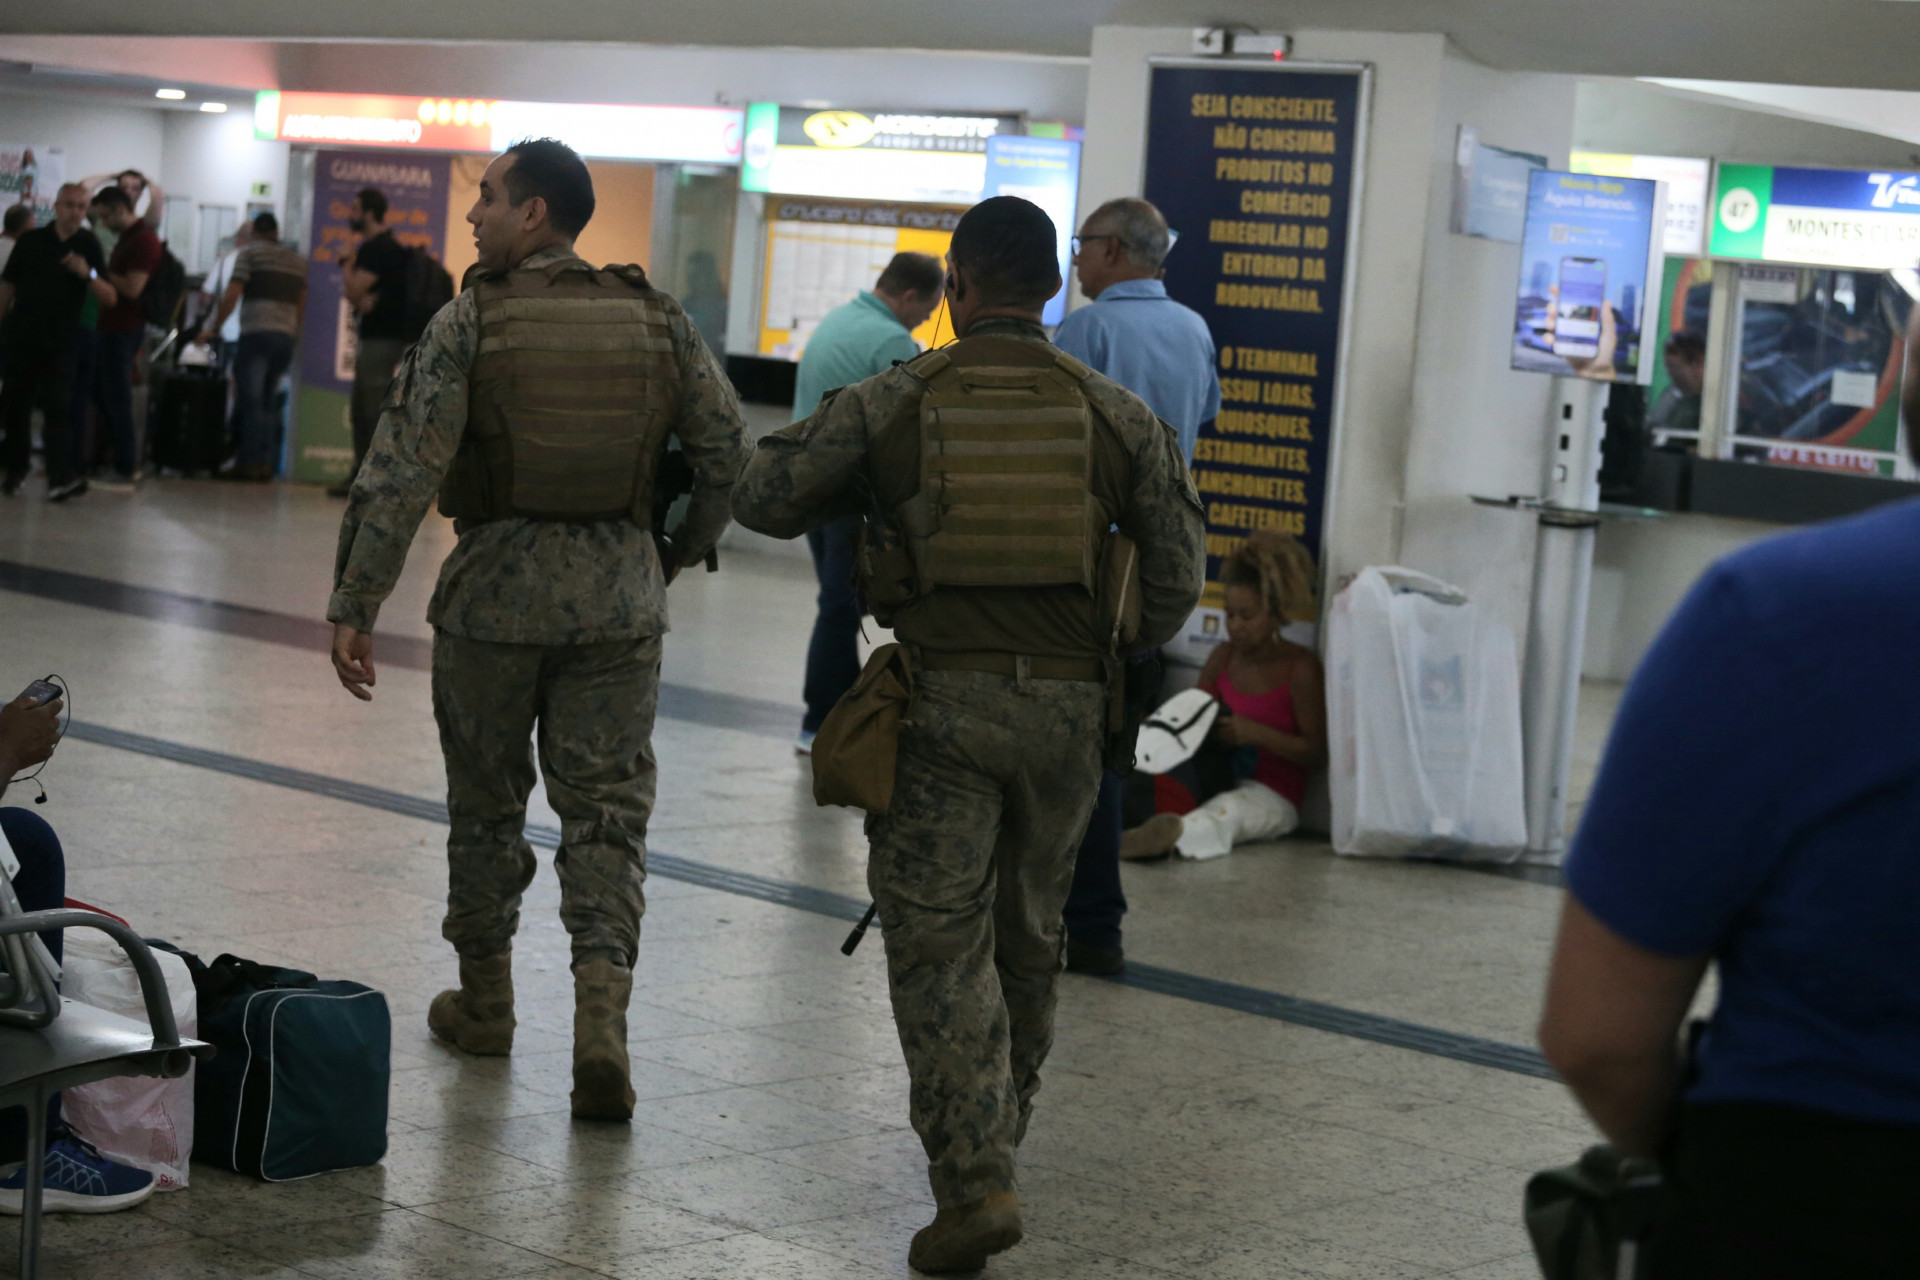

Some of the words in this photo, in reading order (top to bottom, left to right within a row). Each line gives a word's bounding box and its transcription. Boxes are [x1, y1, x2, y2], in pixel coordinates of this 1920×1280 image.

[1191, 93, 1227, 117] SEJA
[1214, 122, 1247, 149] NÃO
[1250, 127, 1336, 154] CONSUMA
[1216, 158, 1305, 184] PRODUTOS
[1309, 163, 1333, 186] NO
[1560, 176, 1595, 191] Novo
[1241, 188, 1331, 217] COMÉRCIO
[1728, 202, 1748, 218] 47
[1209, 219, 1300, 247] IRREGULAR
[1304, 226, 1329, 249] NO
[1786, 218, 1863, 241] MONTES
[1222, 252, 1299, 279] ENTORNO
[1302, 258, 1326, 281] DA
[1220, 346, 1233, 370] O
[1237, 347, 1318, 377] TERMINAL
[1193, 437, 1310, 474] ESTAURANTES,
